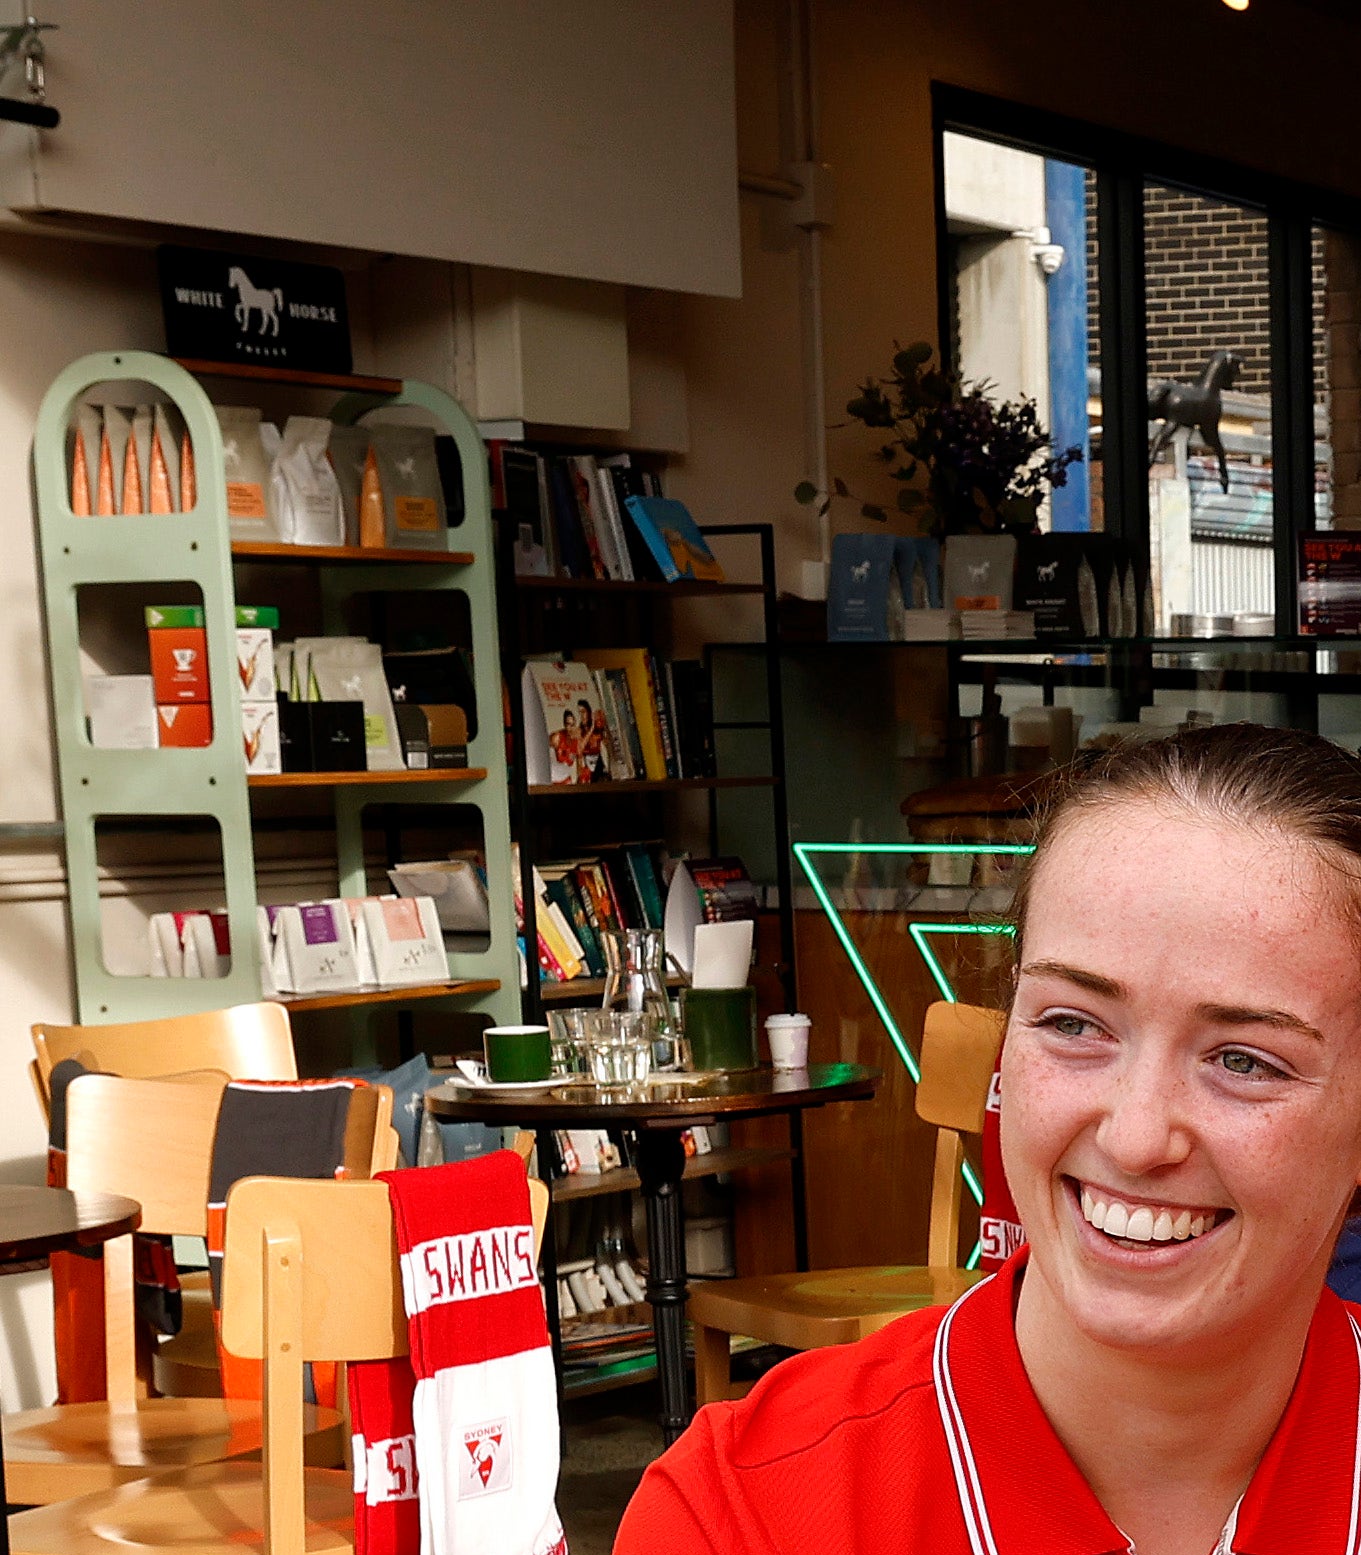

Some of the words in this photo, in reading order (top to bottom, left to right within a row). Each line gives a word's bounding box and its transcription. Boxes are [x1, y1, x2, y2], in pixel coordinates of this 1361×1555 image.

[173, 286, 225, 310] WHITE
[288, 301, 339, 323] HORSE
[422, 1231, 534, 1299] SWANS
